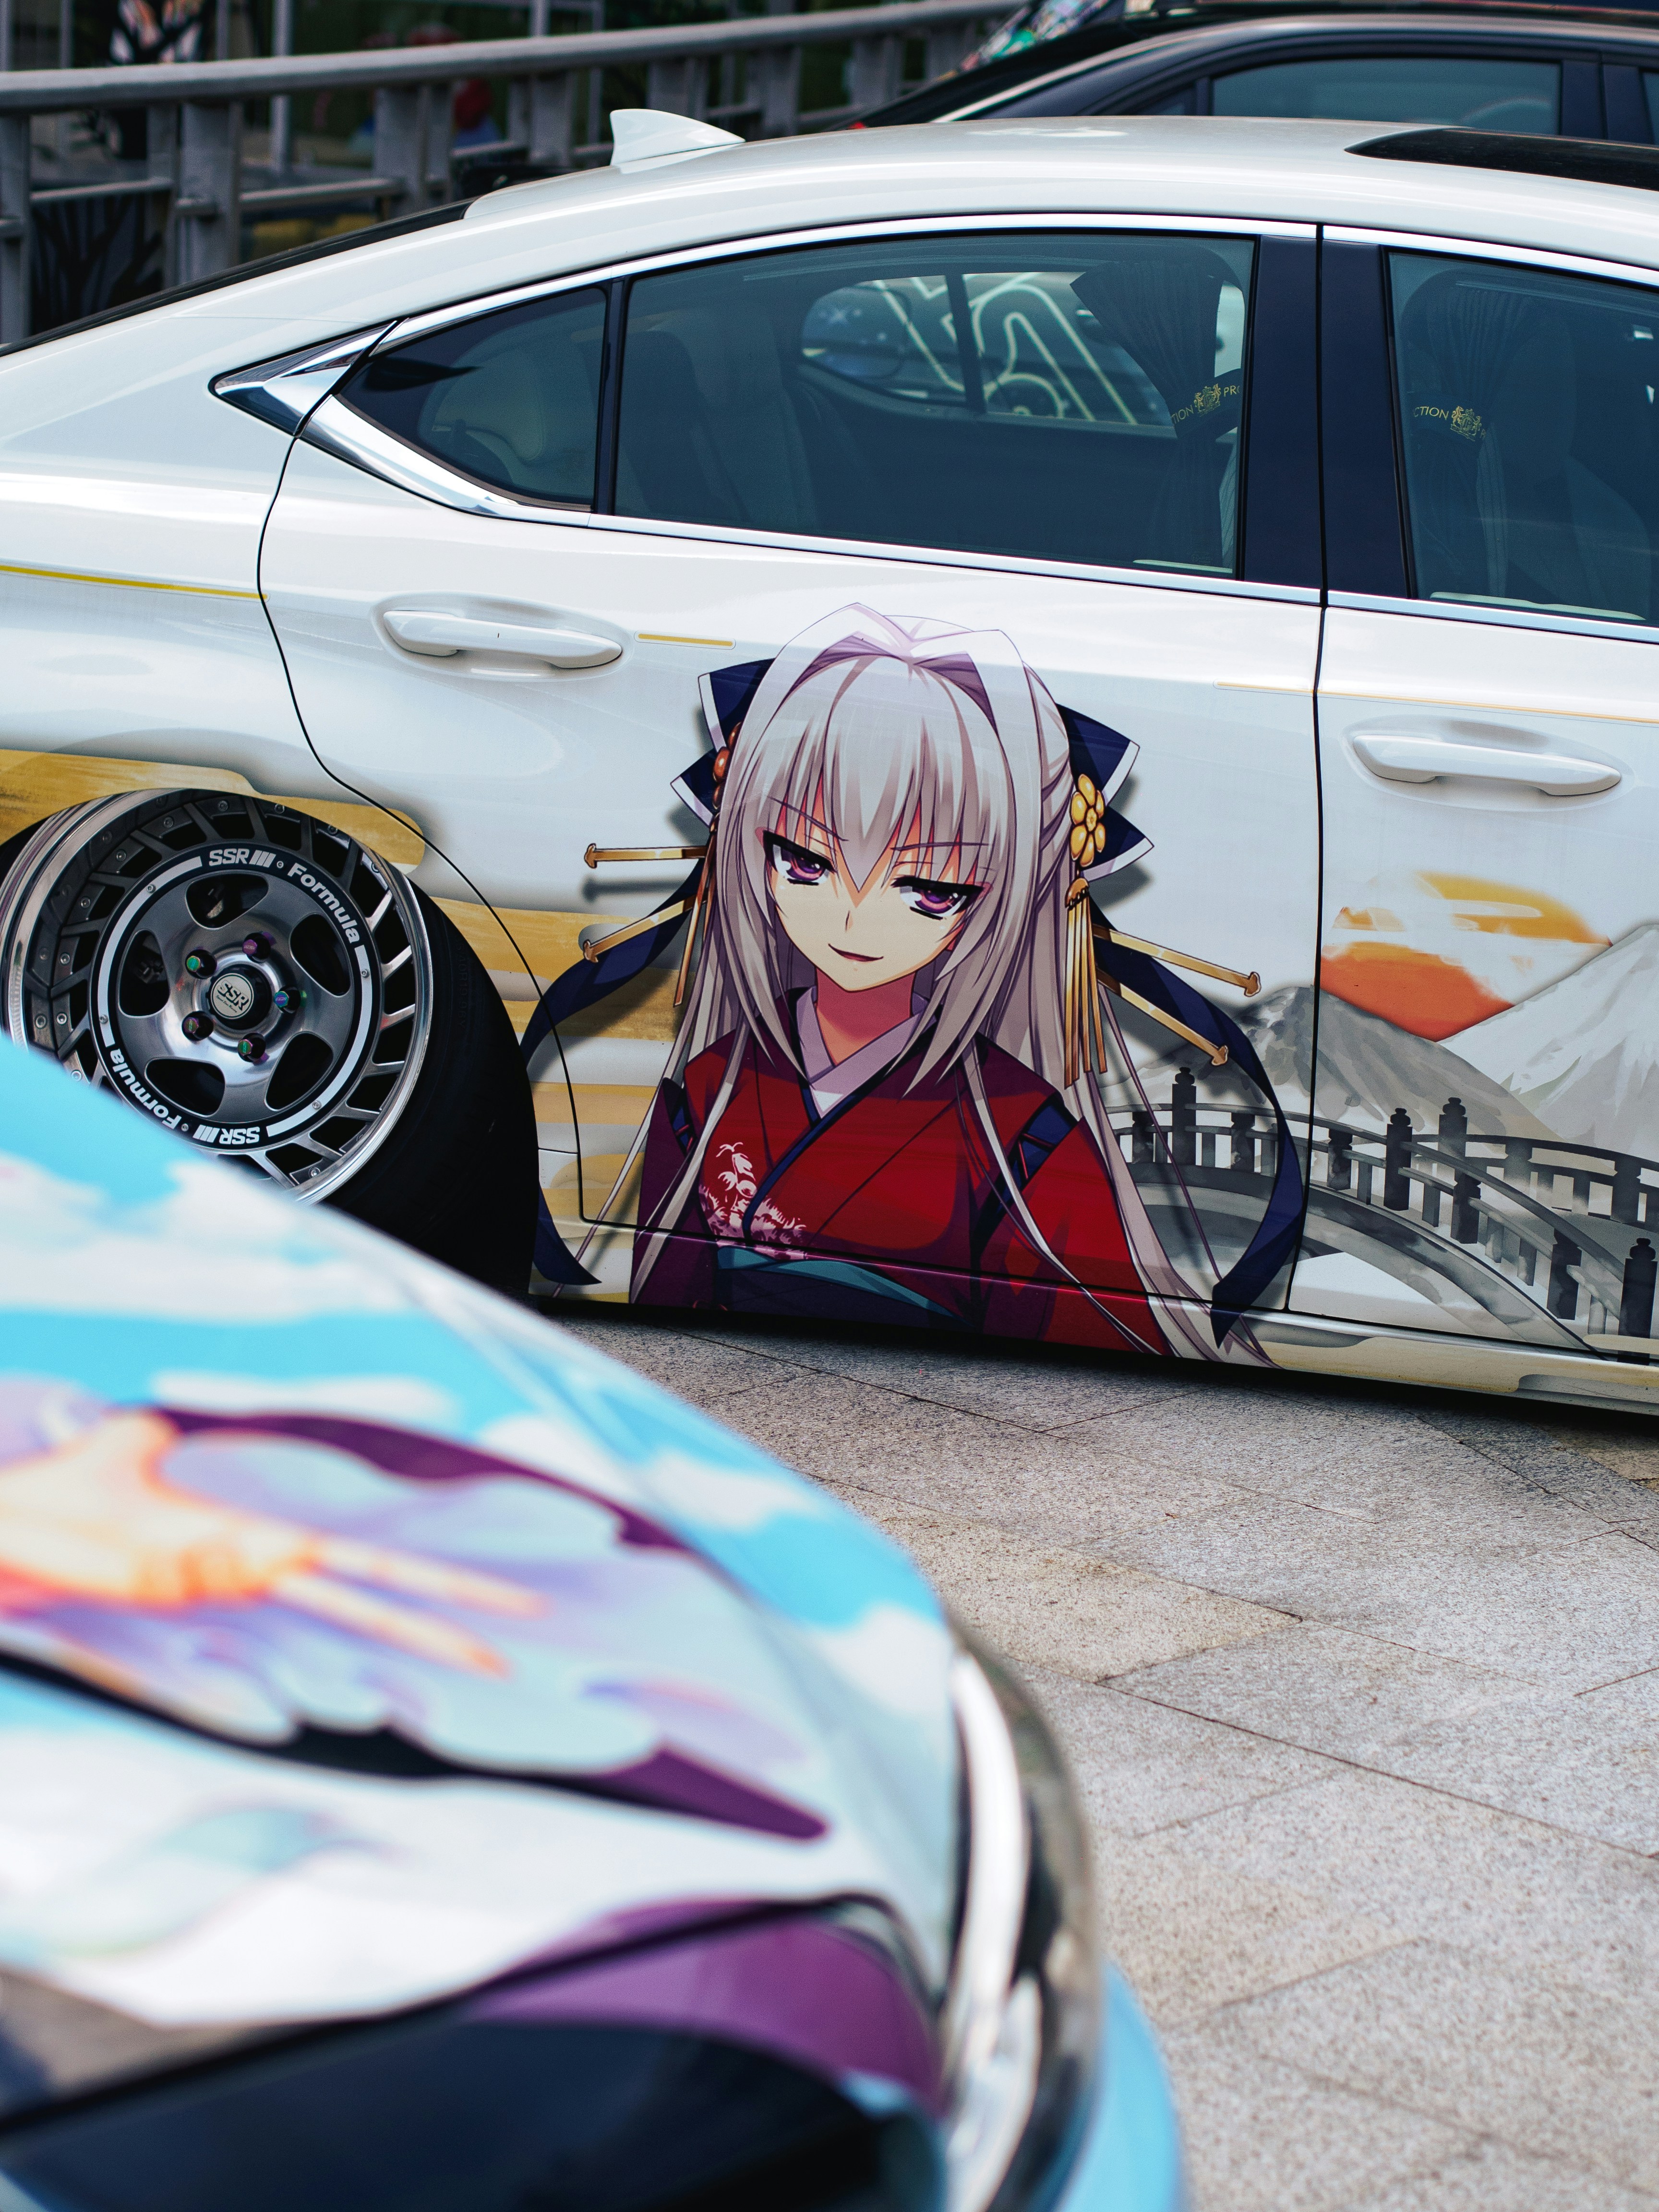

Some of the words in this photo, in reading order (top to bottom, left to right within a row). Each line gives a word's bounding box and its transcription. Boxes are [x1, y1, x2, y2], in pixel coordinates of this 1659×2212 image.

[288, 863, 360, 943] Formula
[216, 979, 249, 1010] SSR
[110, 1048, 181, 1129] Formula
